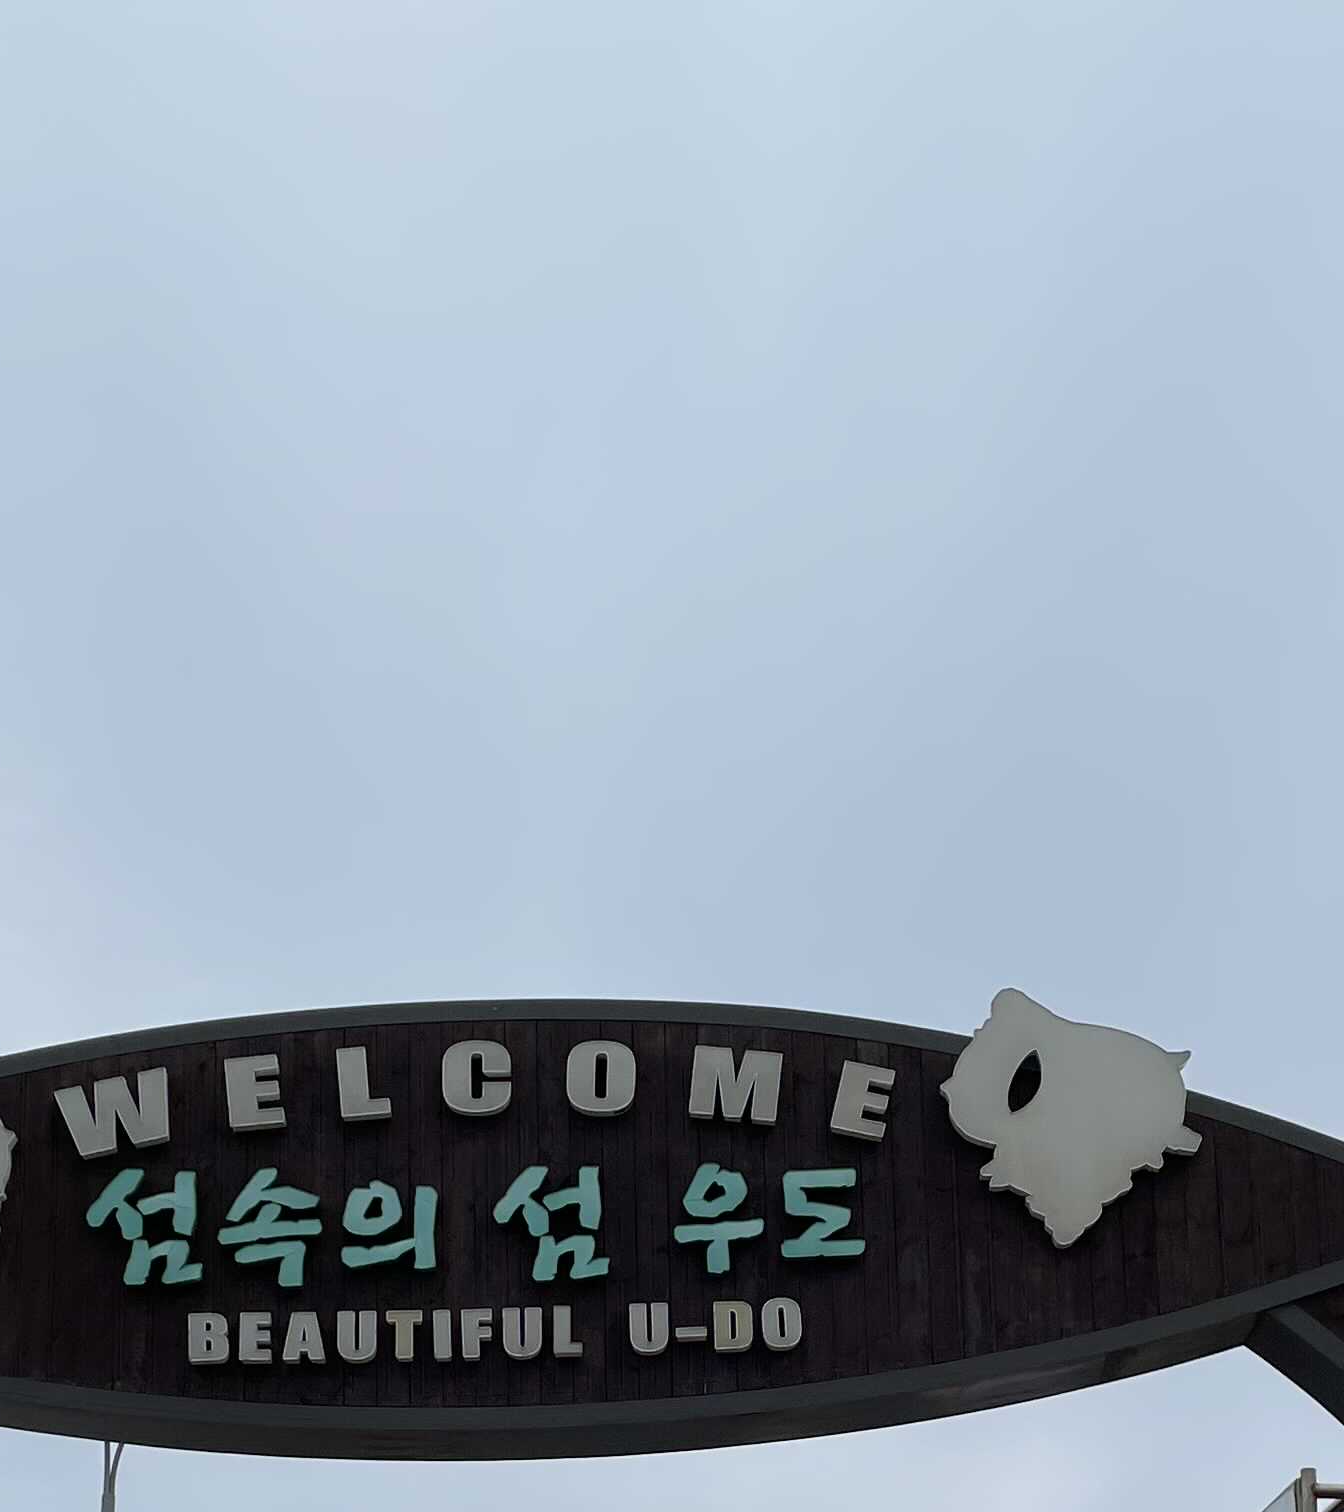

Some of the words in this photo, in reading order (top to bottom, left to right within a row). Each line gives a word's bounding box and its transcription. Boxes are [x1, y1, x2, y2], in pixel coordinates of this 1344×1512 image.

[56, 1039, 896, 1158] WELCOME
[86, 1165, 437, 1286] 섬속의
[493, 1164, 611, 1283] 섬
[674, 1163, 865, 1276] 우도
[188, 1304, 584, 1365] BEAUTIFUL
[629, 1297, 804, 1358] U-DO
